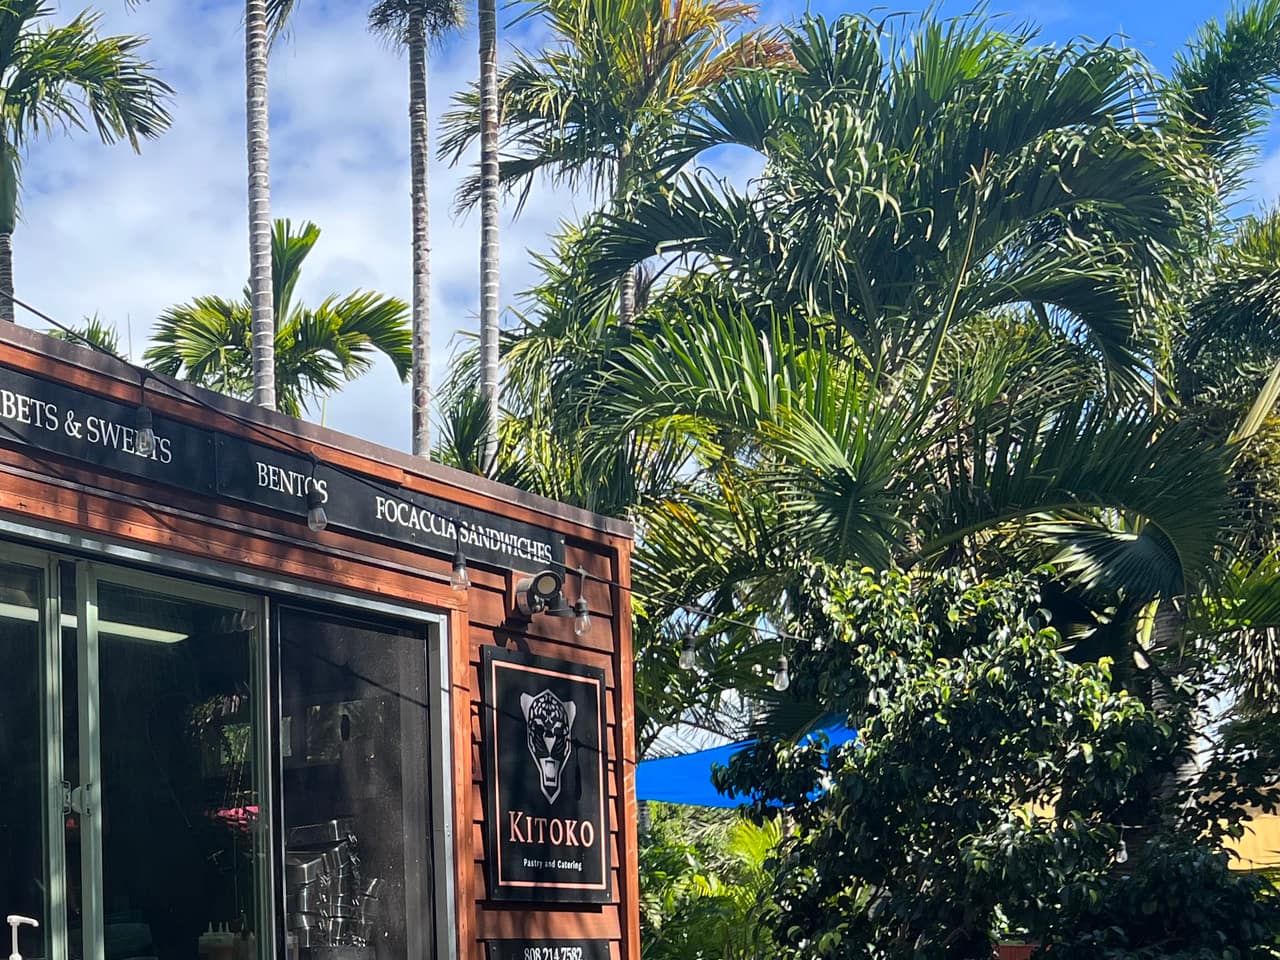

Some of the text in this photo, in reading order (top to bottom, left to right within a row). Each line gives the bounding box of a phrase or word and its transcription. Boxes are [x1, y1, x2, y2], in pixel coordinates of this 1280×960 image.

[65, 412, 82, 440] &
[257, 463, 328, 504] BENTOS
[376, 497, 552, 565] FOCACCIA SANDWICHES
[524, 858, 582, 871] Pastry and Catering
